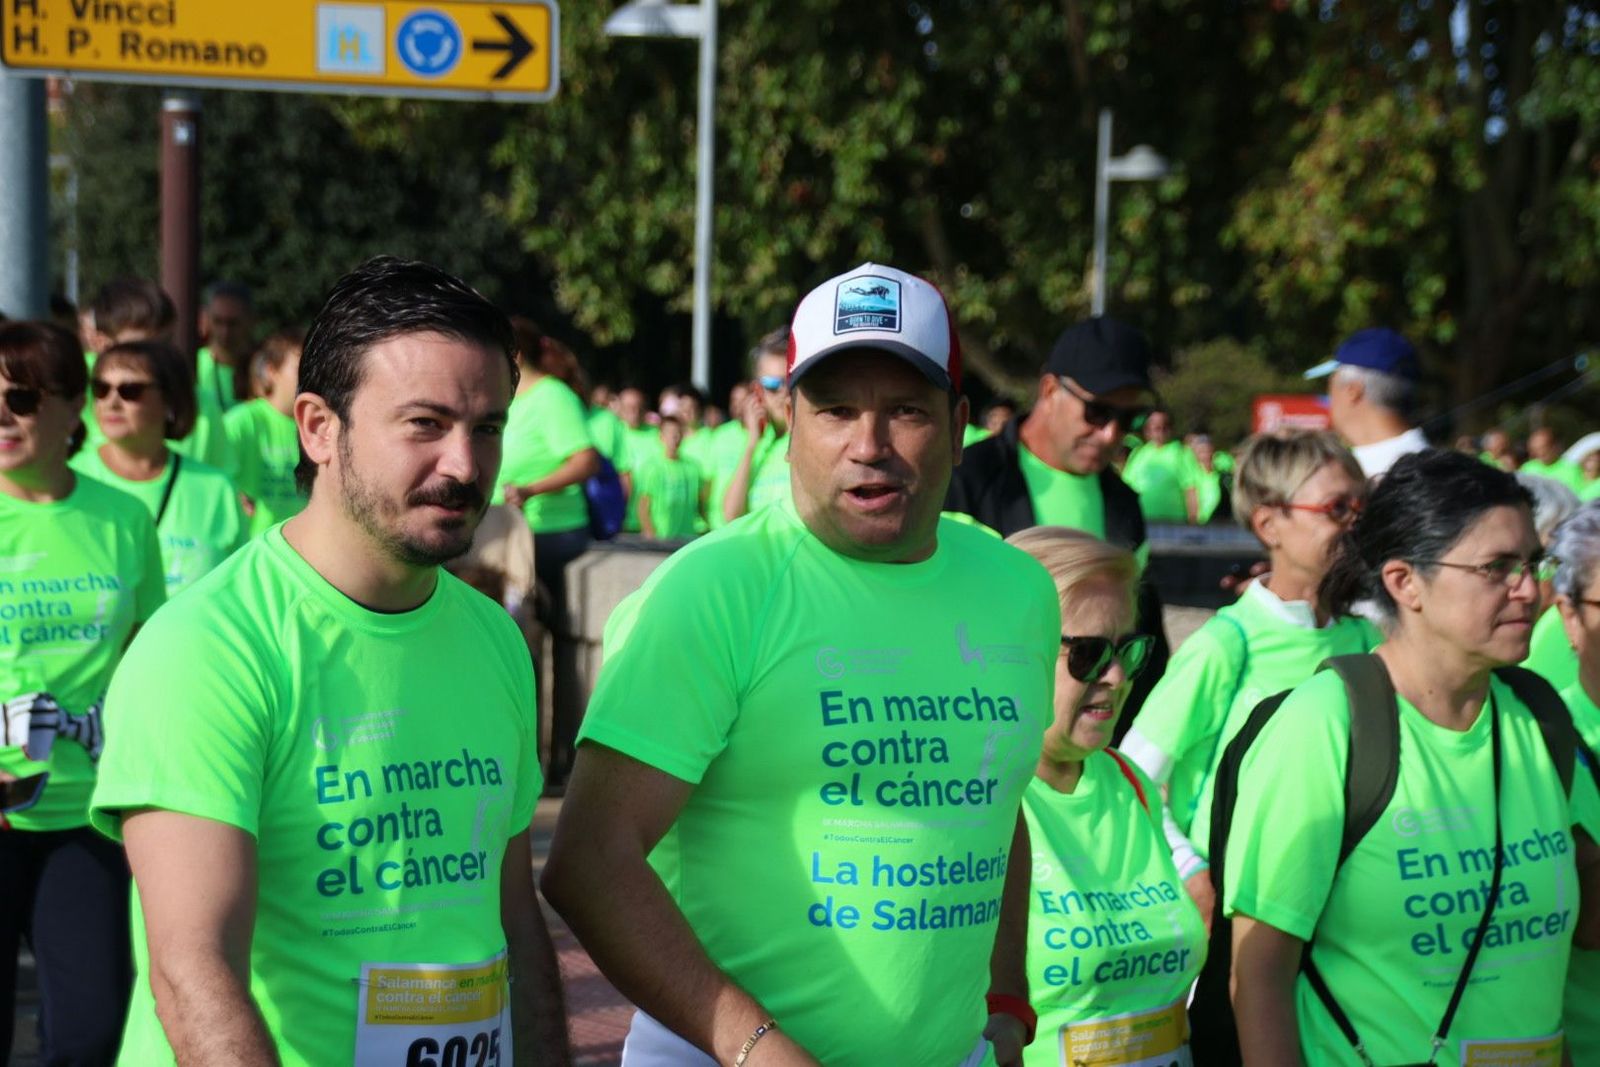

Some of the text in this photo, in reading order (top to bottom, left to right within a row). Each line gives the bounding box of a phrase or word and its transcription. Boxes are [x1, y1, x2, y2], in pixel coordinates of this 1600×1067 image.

[70, 0, 177, 25] Vincci
[13, 24, 48, 55] H.
[120, 30, 268, 68] Romano
[22, 572, 120, 595] marcha
[0, 599, 72, 620] ontra
[820, 687, 1019, 726] En marcha
[822, 730, 949, 767] contra
[316, 748, 502, 804] En marcha
[820, 771, 998, 807] el cáncer
[316, 801, 443, 850] contra
[316, 848, 486, 897] el cáncer
[812, 852, 858, 885] La
[1397, 828, 1568, 881] En marcha
[808, 896, 860, 928] de
[1037, 881, 1180, 915] En marcha
[1404, 879, 1530, 919] contra
[1044, 918, 1152, 950] contra
[1411, 909, 1570, 956] el cáncer
[378, 975, 457, 990] Salamanca
[459, 977, 475, 988] en
[1043, 949, 1190, 986] el cáncer
[376, 991, 425, 1004] contra
[428, 990, 442, 1003] el
